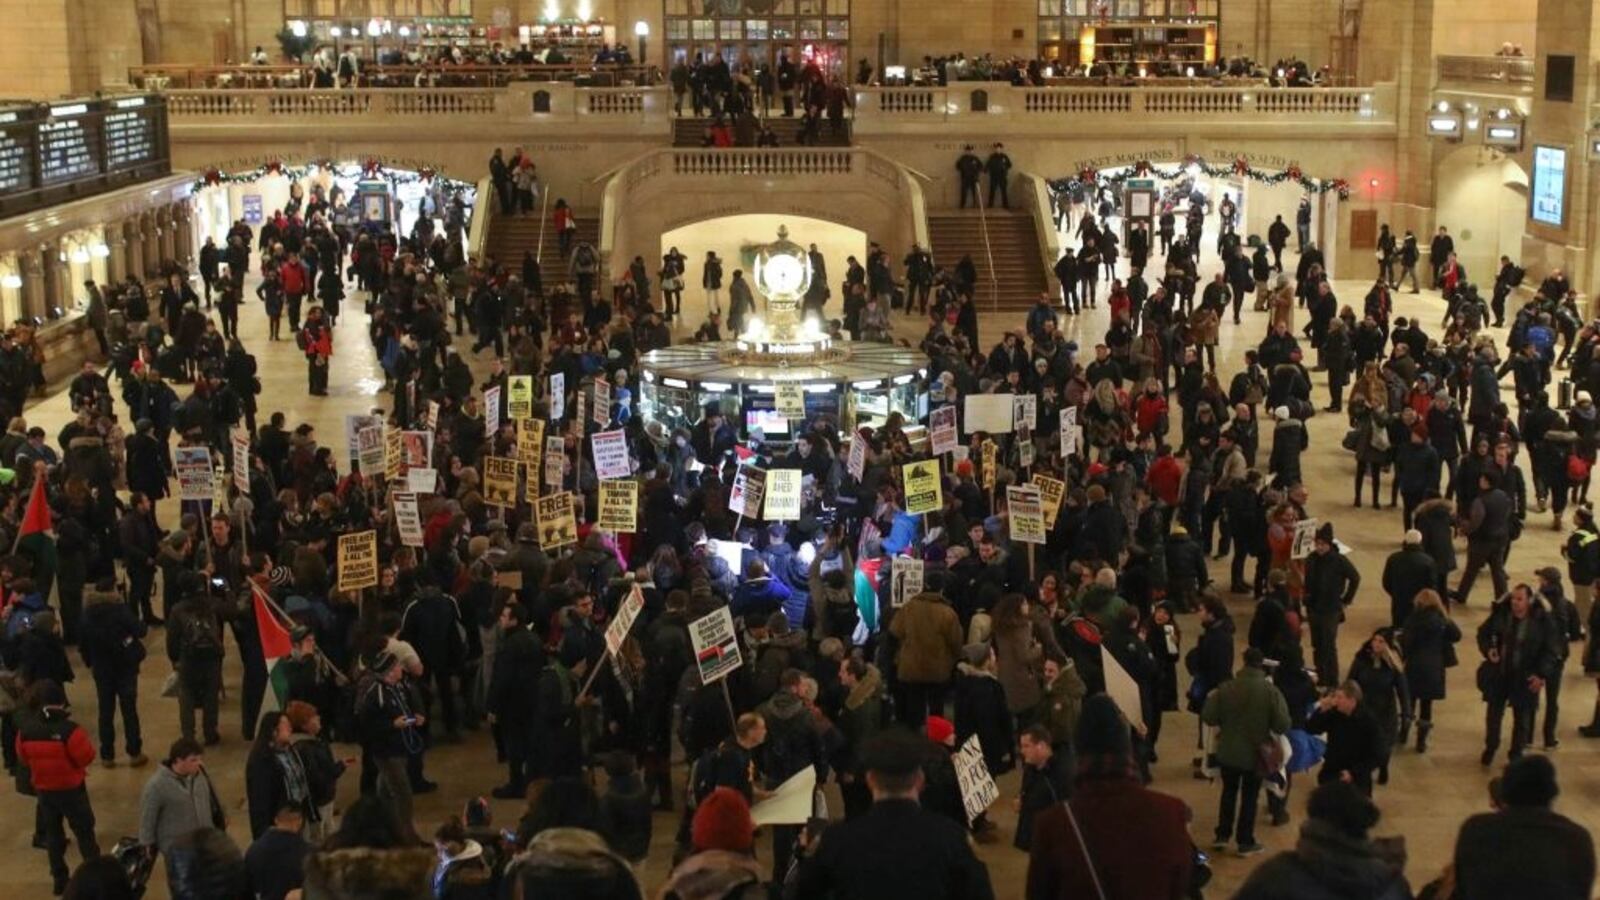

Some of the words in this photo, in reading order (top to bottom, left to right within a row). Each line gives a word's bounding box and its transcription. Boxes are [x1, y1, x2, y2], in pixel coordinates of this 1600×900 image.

[1116, 149, 1173, 161] MACHINES
[487, 458, 516, 473] FREE
[601, 481, 617, 490] FREE
[1034, 476, 1063, 497] FREE
[539, 492, 570, 514] FREE
[540, 509, 571, 523] PALESTINE
